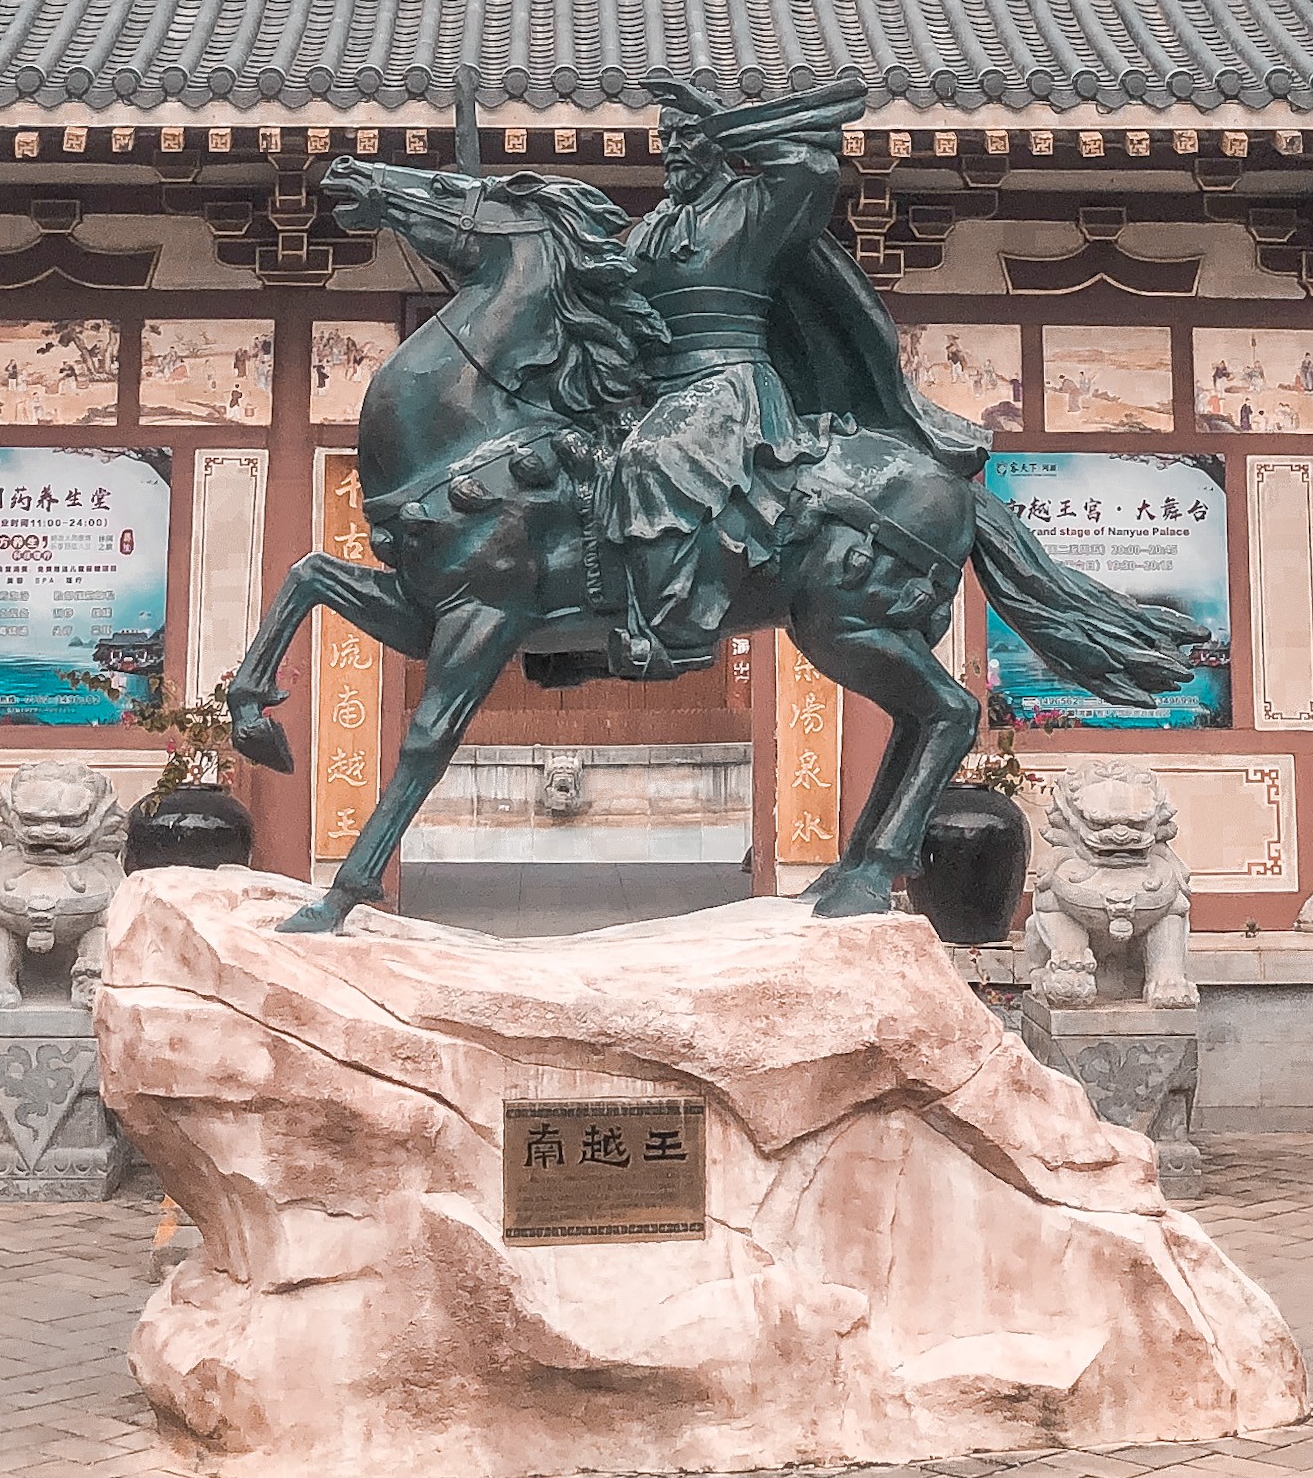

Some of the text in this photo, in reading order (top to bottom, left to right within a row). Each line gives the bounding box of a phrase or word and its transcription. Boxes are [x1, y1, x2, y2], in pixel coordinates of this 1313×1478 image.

[1030, 527, 1190, 538] rand stage of Nanyue Palace
[523, 1122, 687, 1170] 南越王
